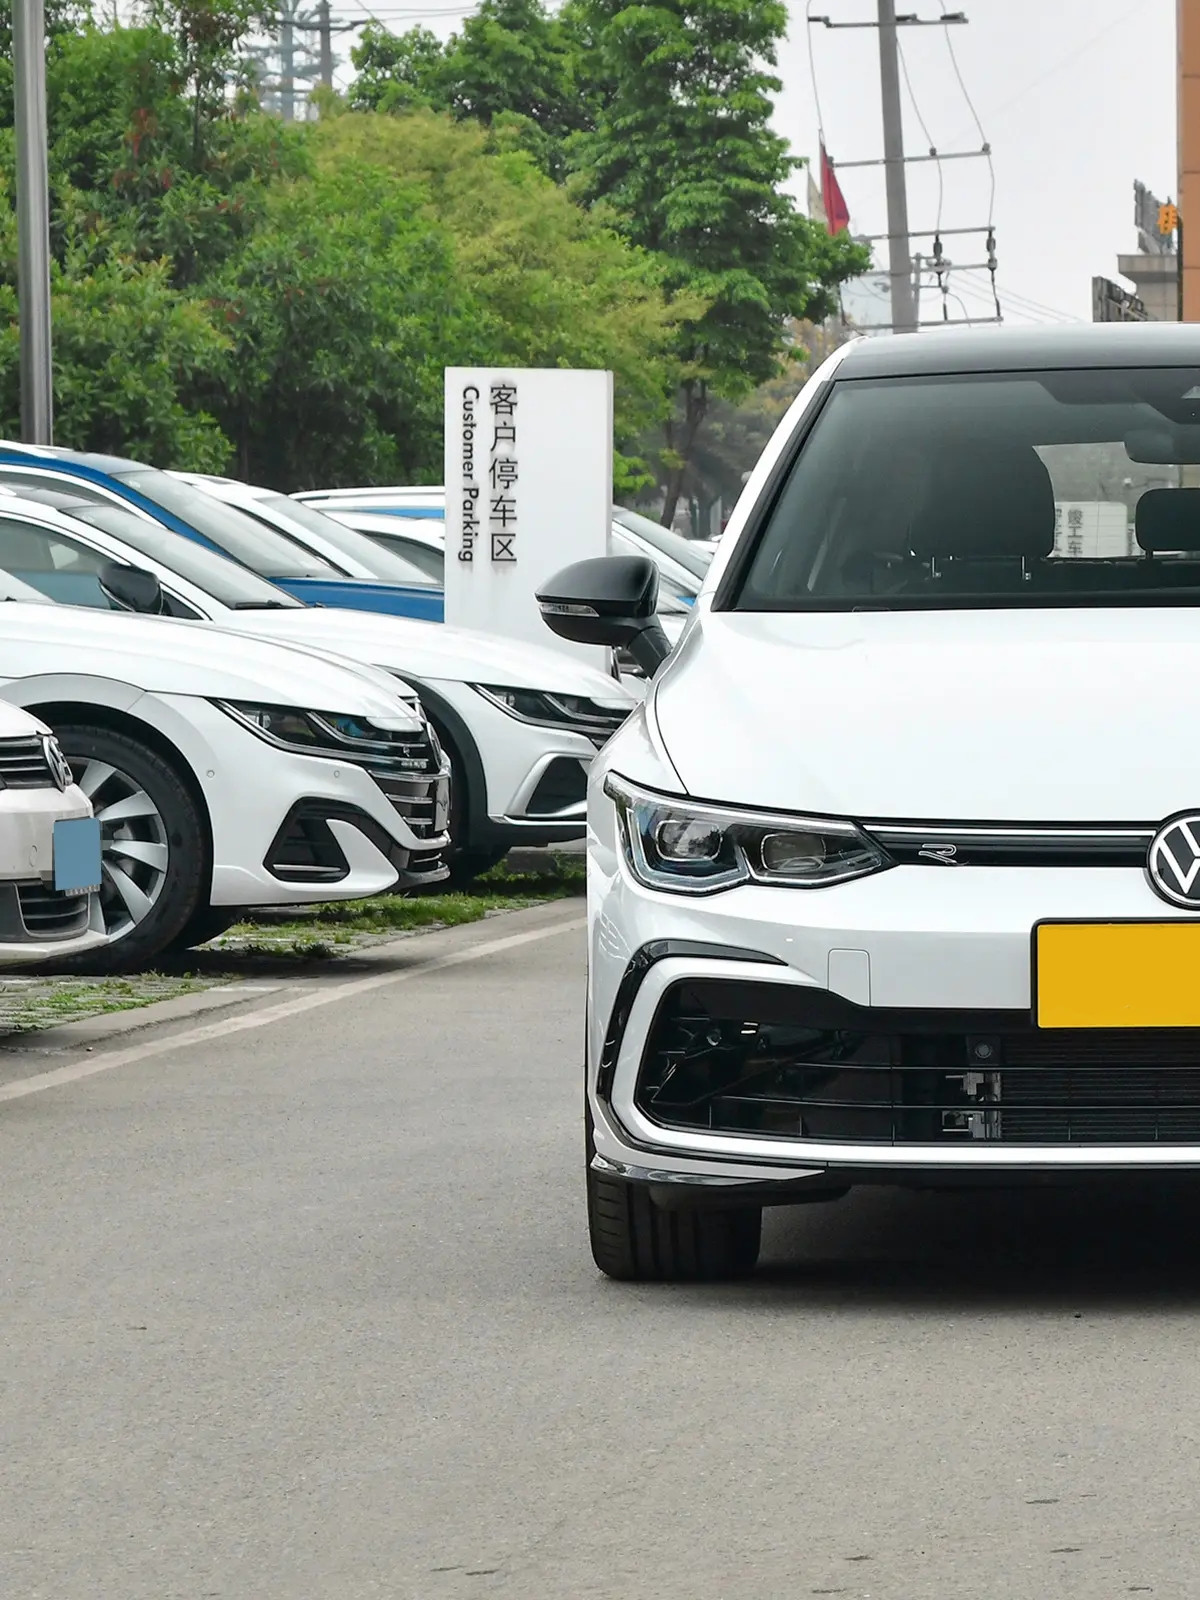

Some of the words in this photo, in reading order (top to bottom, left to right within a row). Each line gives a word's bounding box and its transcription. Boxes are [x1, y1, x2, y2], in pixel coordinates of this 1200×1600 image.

[462, 385, 480, 480] Customer
[489, 384, 518, 562] 客户停车区
[458, 487, 480, 562] Parking
[918, 843, 957, 865] R
